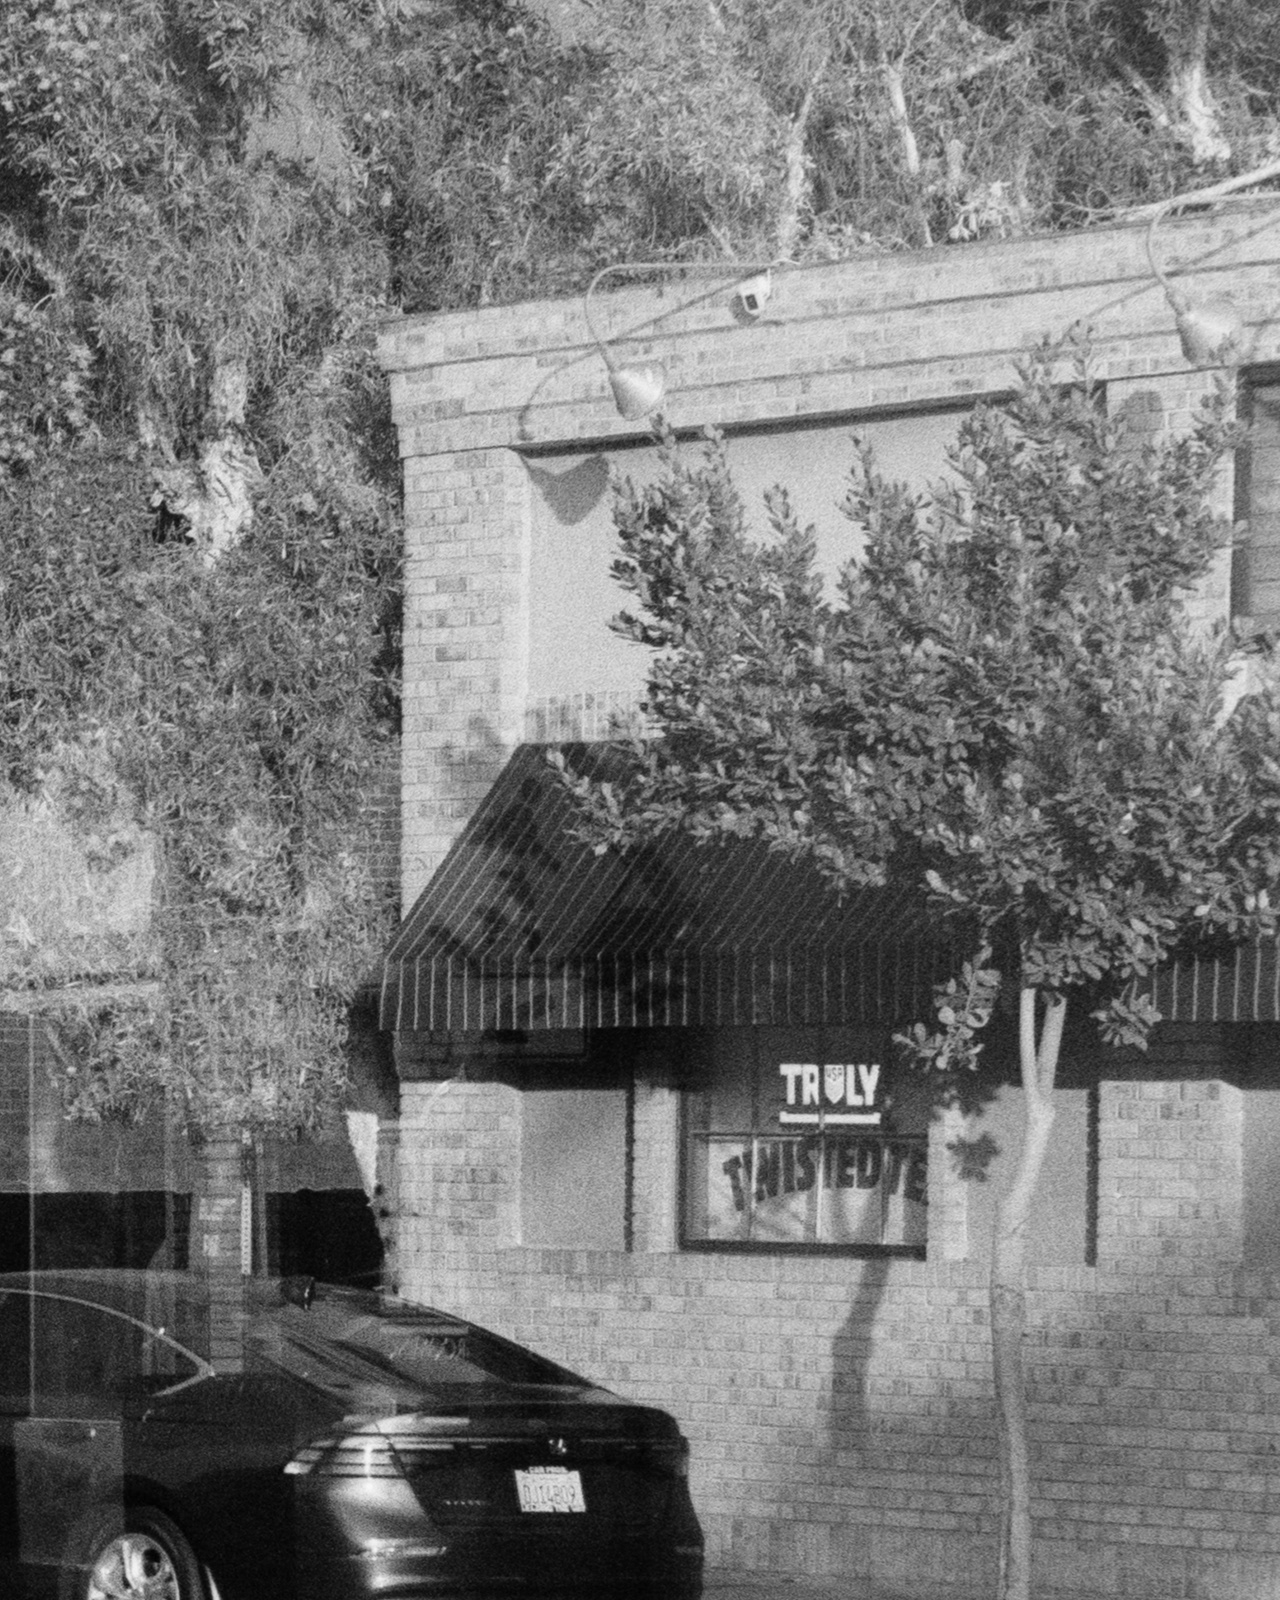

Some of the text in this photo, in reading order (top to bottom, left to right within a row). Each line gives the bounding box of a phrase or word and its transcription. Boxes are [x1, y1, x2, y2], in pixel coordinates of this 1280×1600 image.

[779, 1063, 881, 1106] TRULY
[723, 1137, 928, 1211] TWISTED TE
